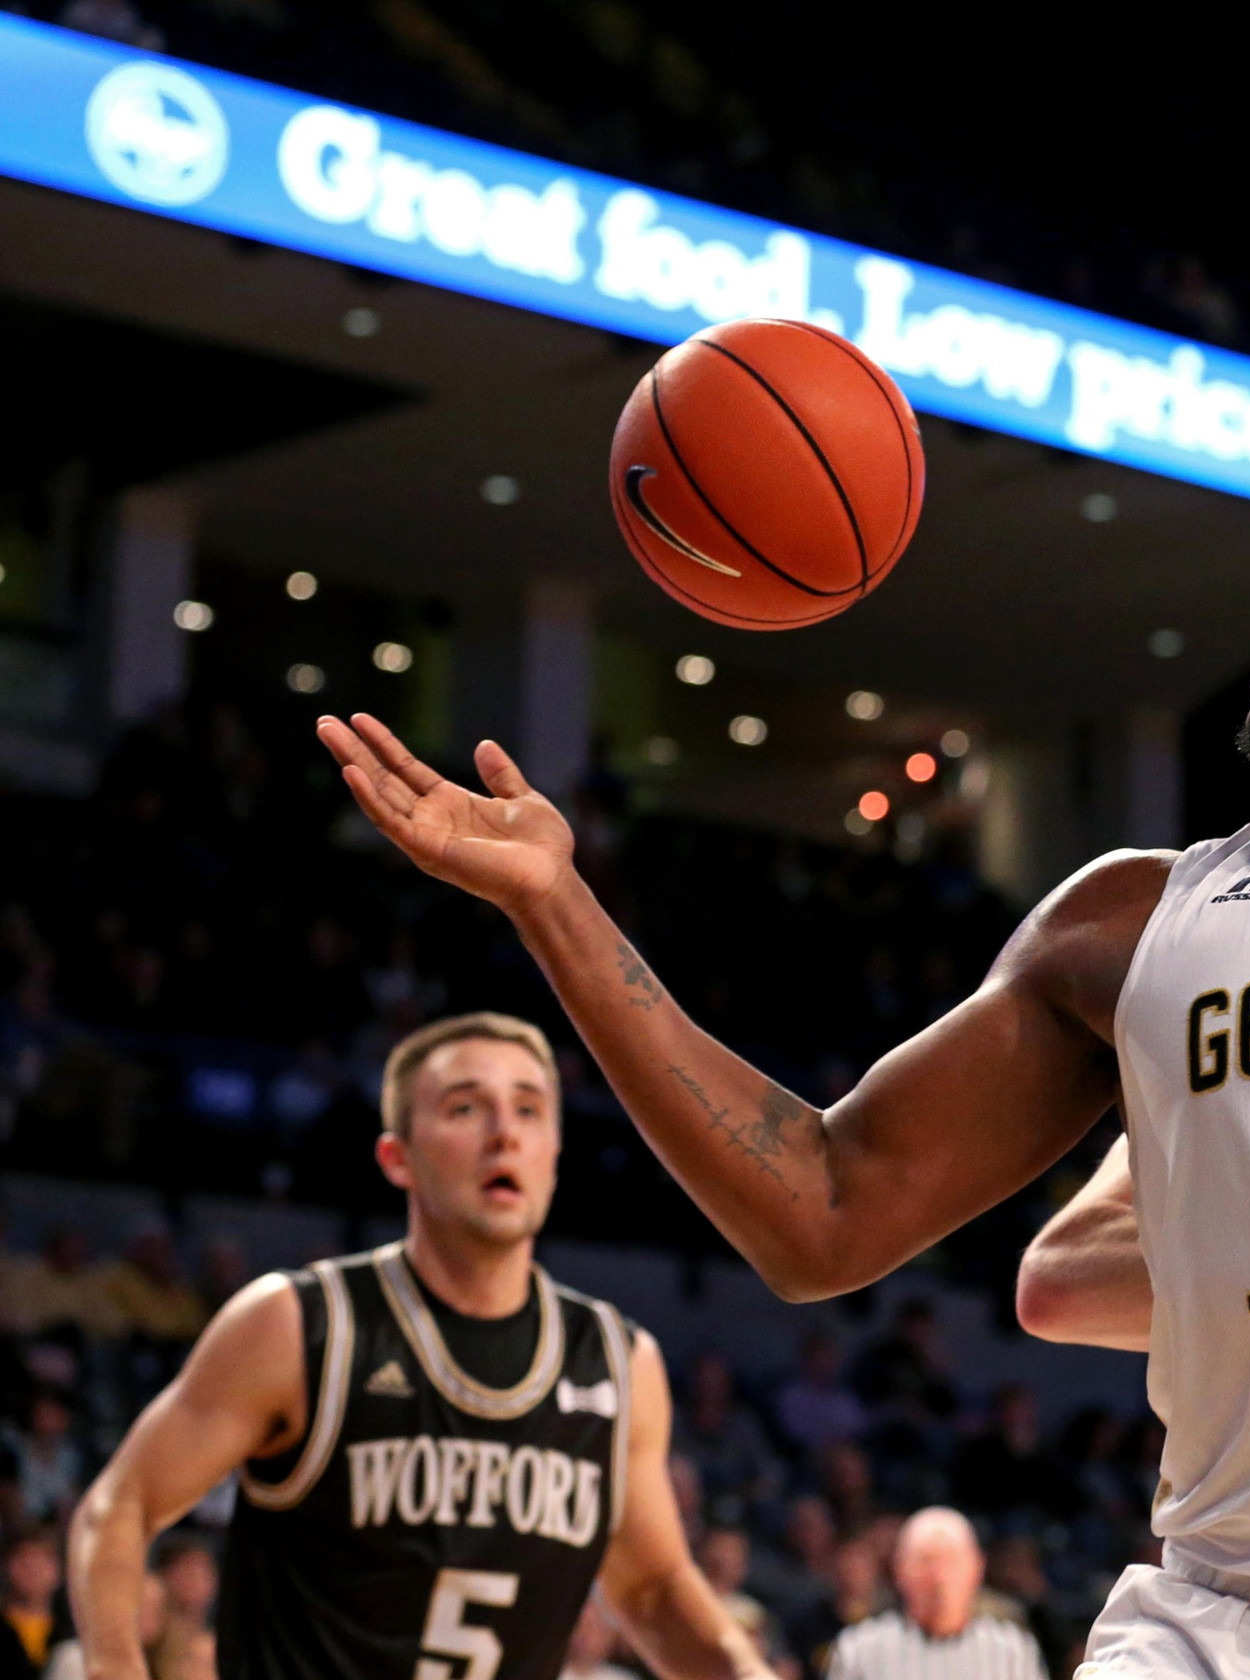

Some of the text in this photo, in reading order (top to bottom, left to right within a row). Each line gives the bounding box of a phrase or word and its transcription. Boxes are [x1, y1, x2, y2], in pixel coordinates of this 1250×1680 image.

[279, 105, 586, 284] Great
[855, 258, 1062, 407] Low
[414, 1569, 519, 1680] 5
